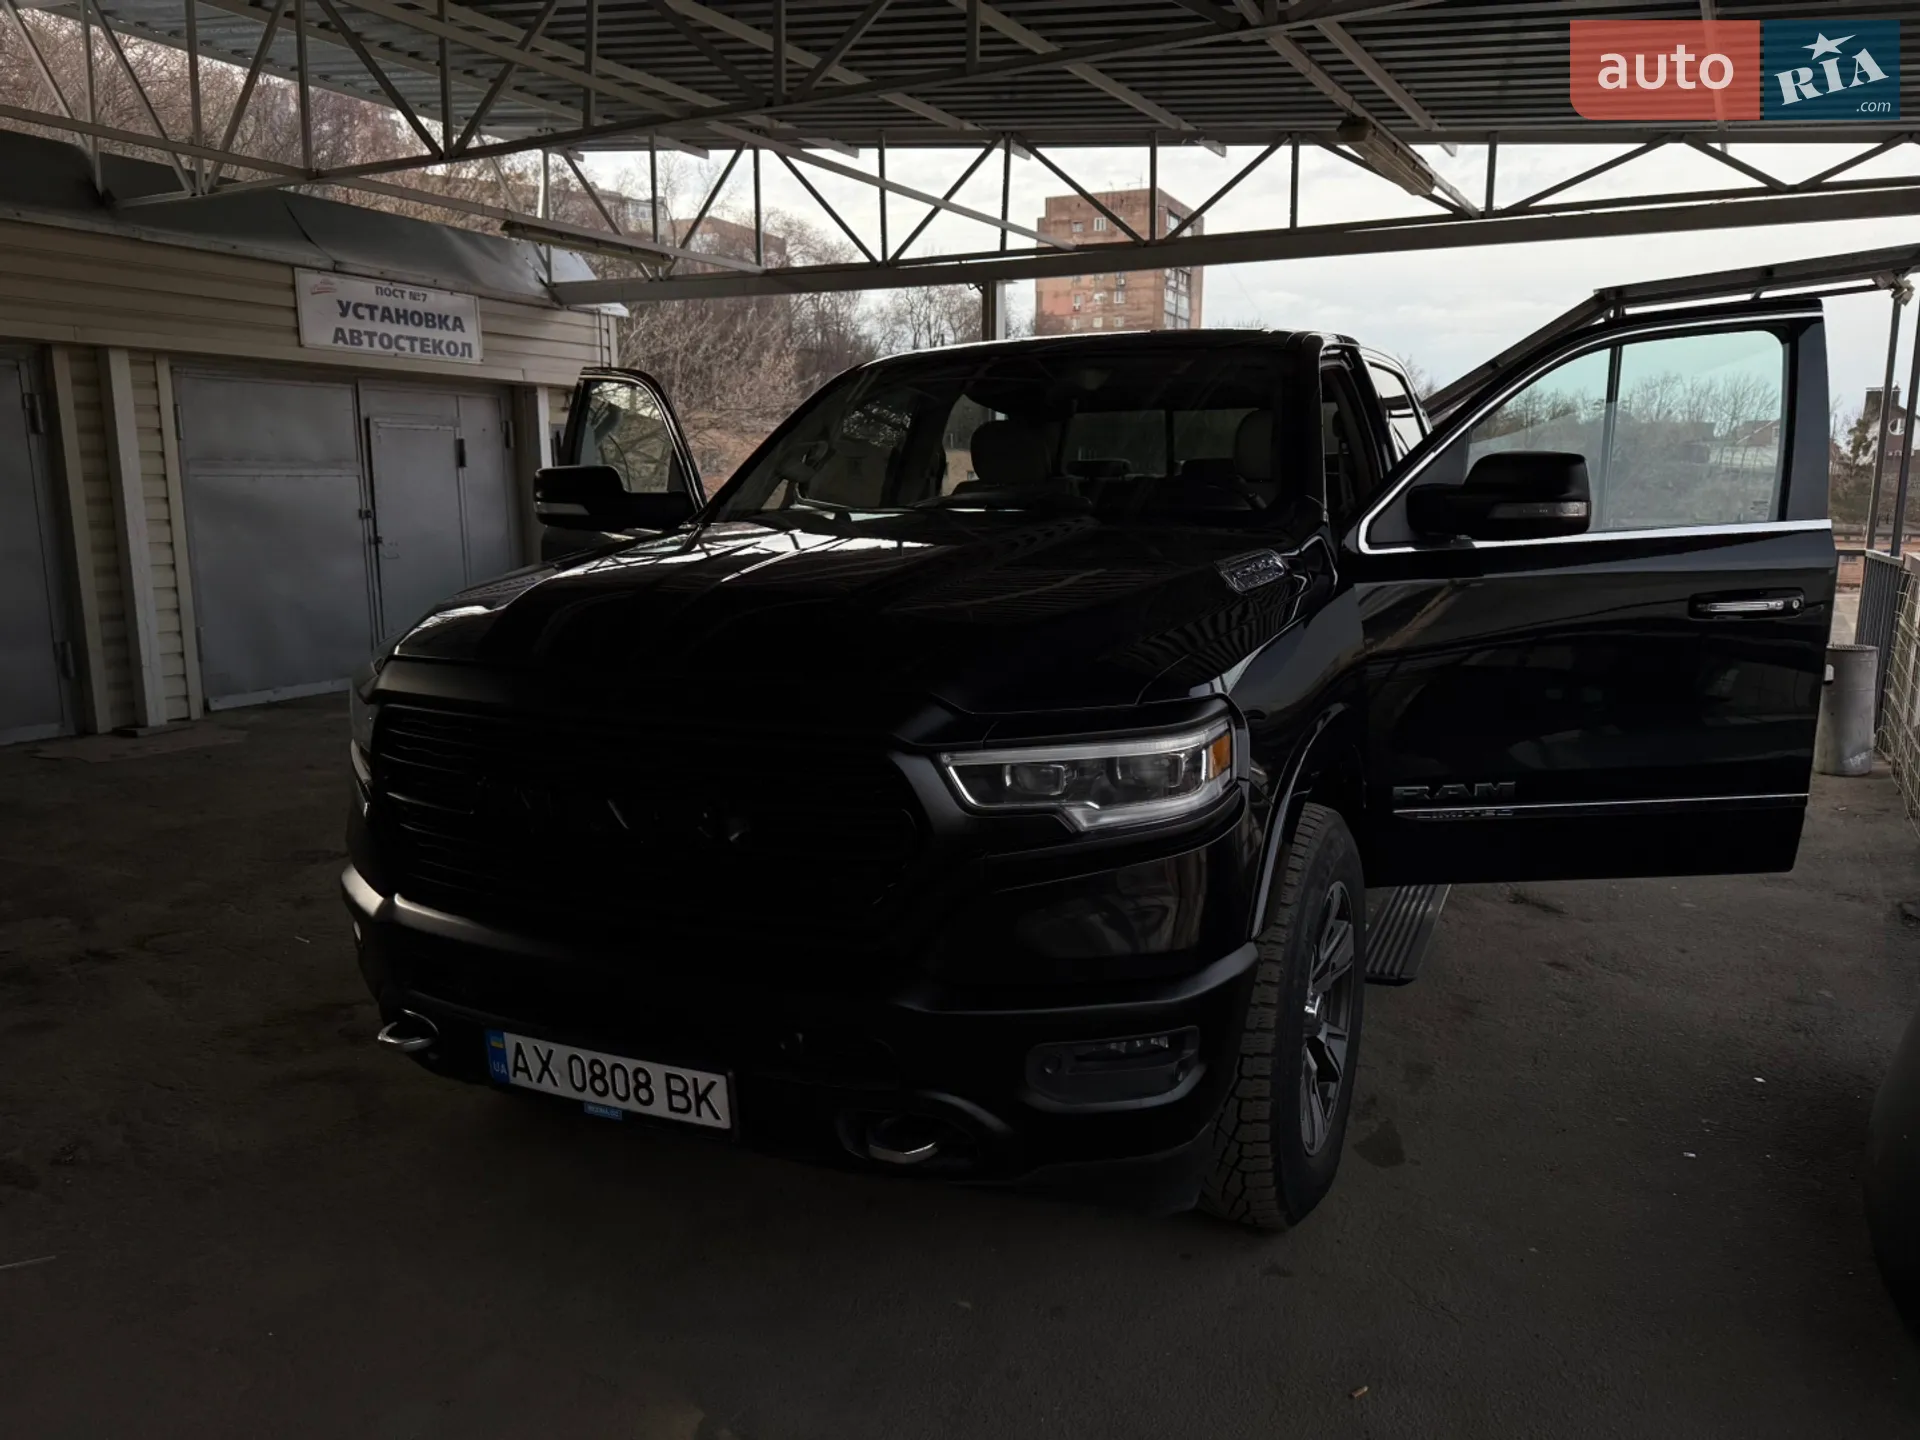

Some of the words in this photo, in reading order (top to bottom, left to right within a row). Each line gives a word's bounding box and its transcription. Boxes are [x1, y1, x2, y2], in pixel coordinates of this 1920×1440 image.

[374, 285, 406, 299] ПОСТ
[409, 290, 428, 302] №7
[336, 299, 466, 333] УСТАНОВКА
[332, 326, 473, 359] АВТОСТЕКОЛ
[1391, 780, 1517, 802] RAM
[493, 1059, 508, 1076] UA
[512, 1042, 559, 1087] AX
[567, 1054, 655, 1106] 0808
[665, 1072, 721, 1121] BK
